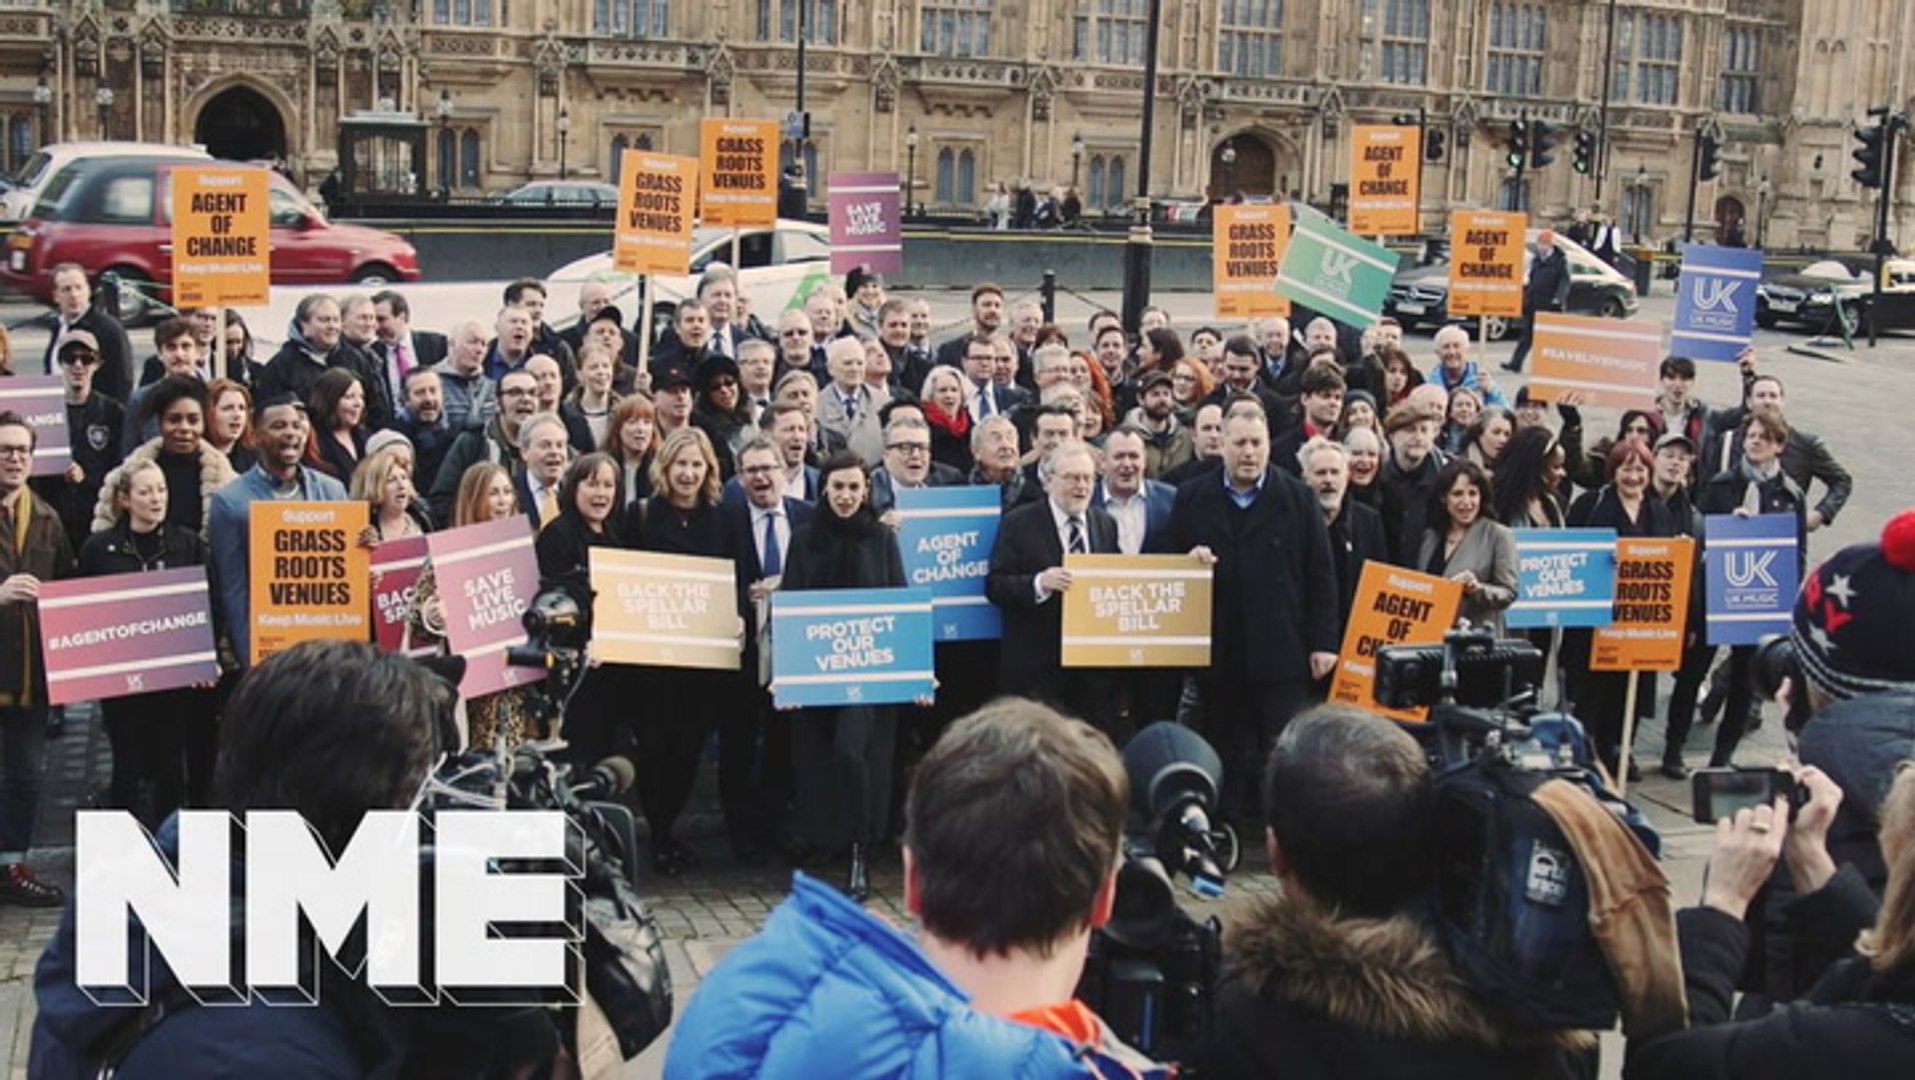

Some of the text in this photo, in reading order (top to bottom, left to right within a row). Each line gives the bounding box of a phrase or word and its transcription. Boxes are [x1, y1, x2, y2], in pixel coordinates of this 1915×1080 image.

[716, 138, 764, 153] GRASS
[1364, 146, 1403, 161] AGENT
[716, 155, 763, 171] ROOTS
[1377, 162, 1392, 178] OF
[636, 172, 682, 192] GRASS
[713, 172, 765, 190] VENUES
[1360, 179, 1409, 195] CHANGE
[191, 192, 247, 213] AGENT
[634, 192, 680, 213] ROOTS
[846, 202, 882, 216] SAVE
[211, 214, 233, 234] OF
[630, 210, 682, 232] VENUES
[846, 221, 886, 236] MUSIC
[850, 212, 880, 226] LIVE
[1229, 223, 1275, 240] GRASS
[1466, 230, 1509, 246] AGENT
[186, 237, 256, 256] CHANGE
[1229, 242, 1275, 259] ROOTS
[1479, 247, 1495, 261] OF
[1226, 261, 1278, 277] VENUES
[1321, 247, 1361, 284] UK
[1460, 262, 1513, 279] CHANGE
[1694, 277, 1741, 313] UK
[282, 510, 336, 524] Support
[274, 529, 346, 552] GRASS
[917, 531, 980, 554] AGENT
[936, 548, 963, 566] OF
[1521, 552, 1588, 572] PROTECT
[275, 555, 346, 579] ROOTS
[912, 559, 989, 583] CHANGE
[1538, 568, 1571, 582] OUR
[1619, 561, 1674, 580] GRASS
[1724, 551, 1779, 587] UK
[463, 567, 515, 598] SAVE
[617, 582, 711, 599] BACK THE
[1089, 581, 1185, 602] BACK THE
[1525, 579, 1584, 598] VENUES
[1617, 582, 1671, 601] ROOTS
[269, 582, 350, 605] VENUES
[377, 587, 413, 609] BAC
[472, 585, 515, 612] LIVE
[623, 597, 707, 614] SPELLAR
[1095, 598, 1181, 618] SPELLAR
[1373, 591, 1434, 622] AGENT
[1613, 604, 1672, 622] VENUES
[258, 612, 361, 627] Keep Music Live
[468, 599, 527, 632] MUSIC
[647, 613, 688, 629] BILL
[1118, 615, 1160, 632] BILL
[48, 611, 209, 650] #AGENTOFCHANGE
[806, 615, 895, 641] PROTECT
[1387, 618, 1412, 640] OF
[832, 635, 875, 653] OUR
[815, 648, 895, 672] VENUES
